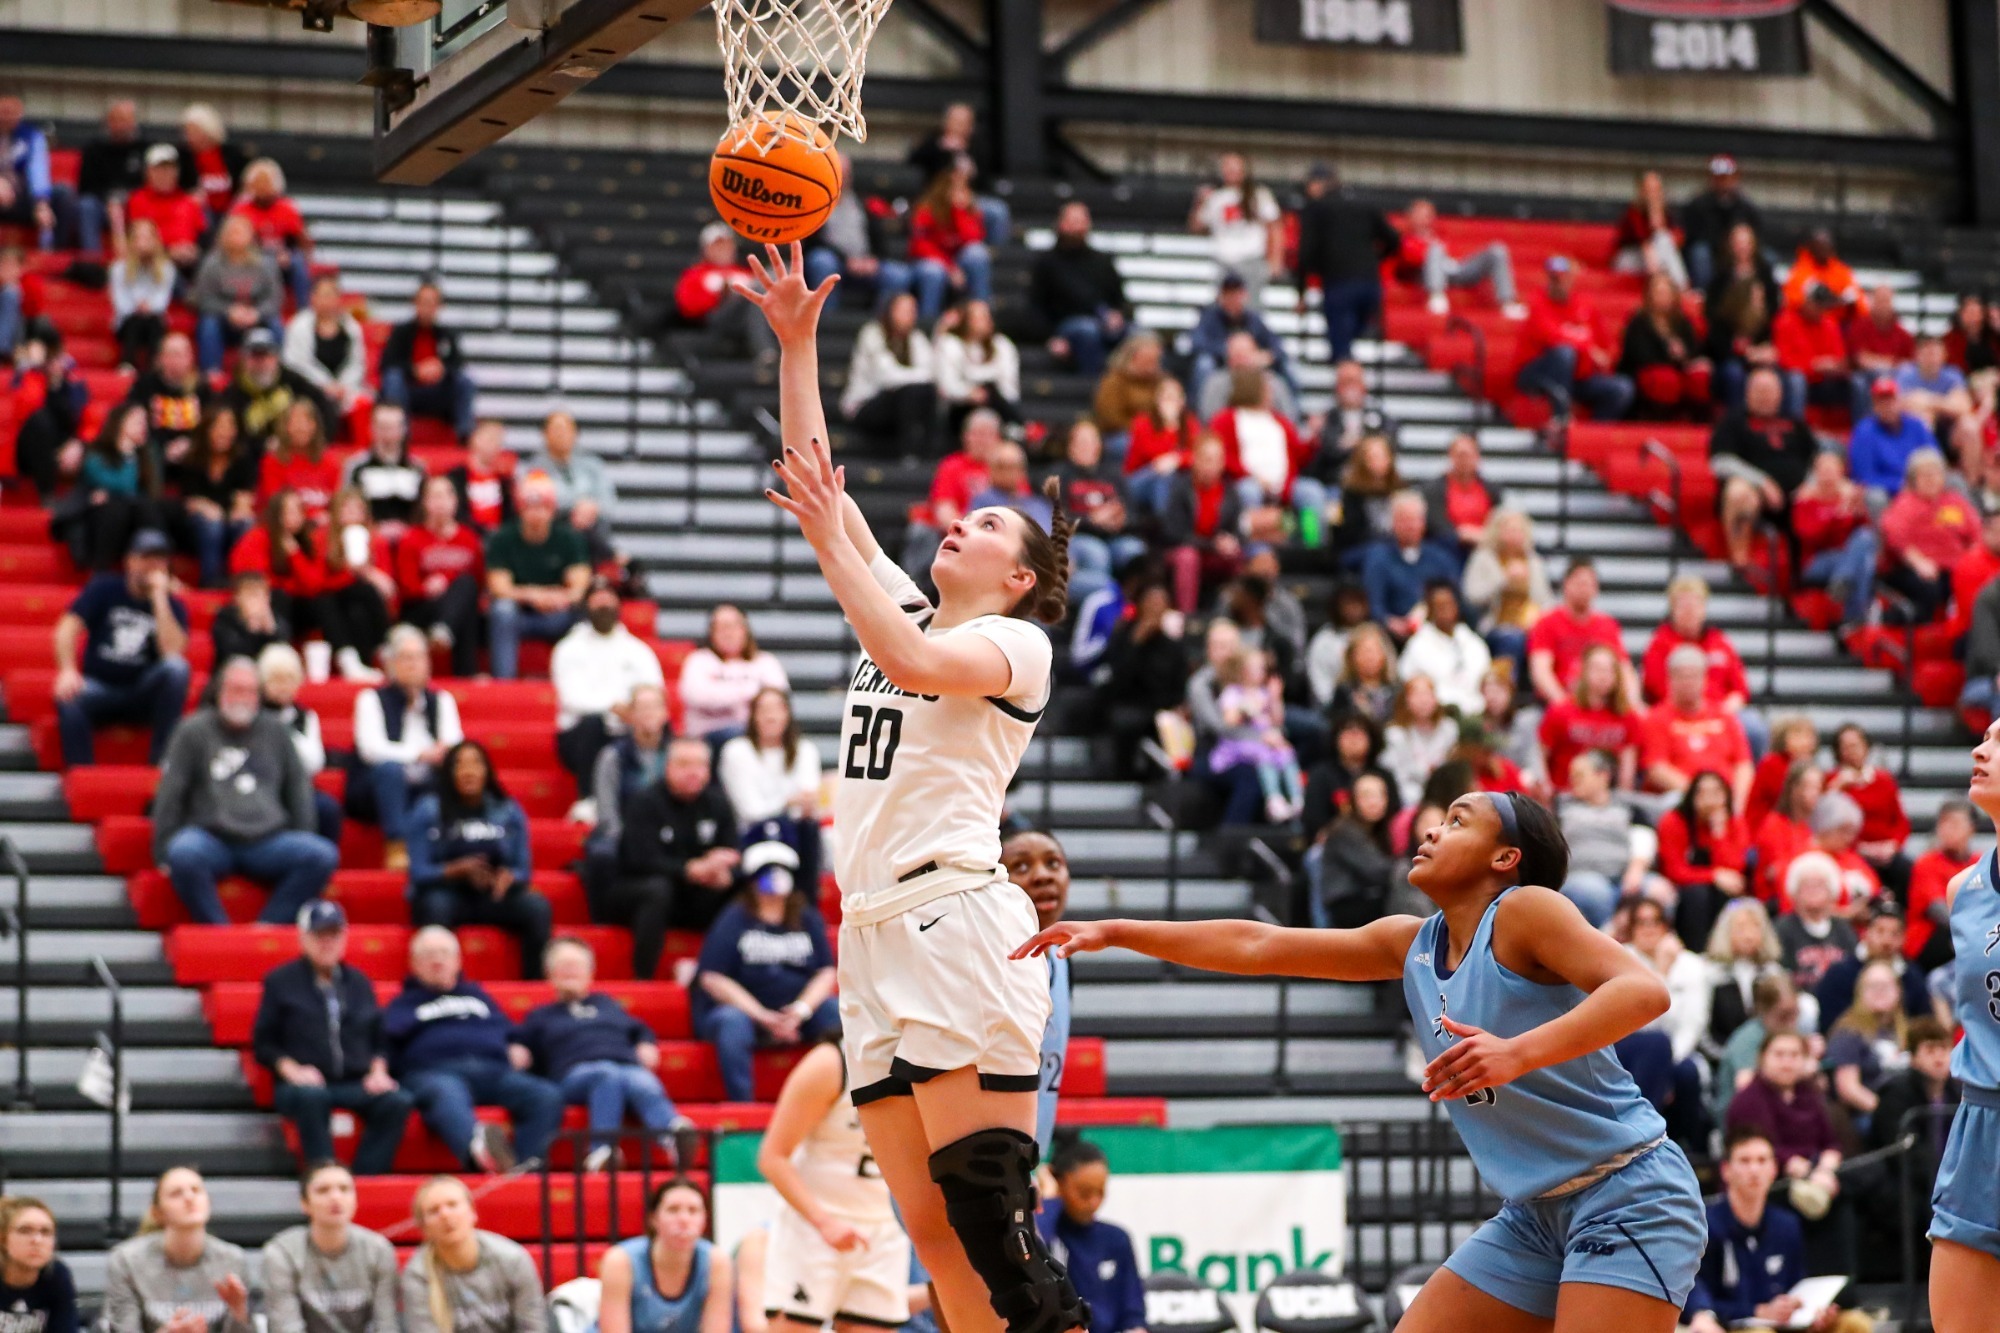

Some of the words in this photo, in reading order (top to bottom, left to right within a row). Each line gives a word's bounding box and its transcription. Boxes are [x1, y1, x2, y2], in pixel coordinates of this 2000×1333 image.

[1651, 21, 1757, 70] 2014
[722, 166, 803, 210] Wilson
[845, 704, 903, 780] 20
[1150, 1227, 1332, 1292] Bank
[1266, 1283, 1359, 1321] UCM
